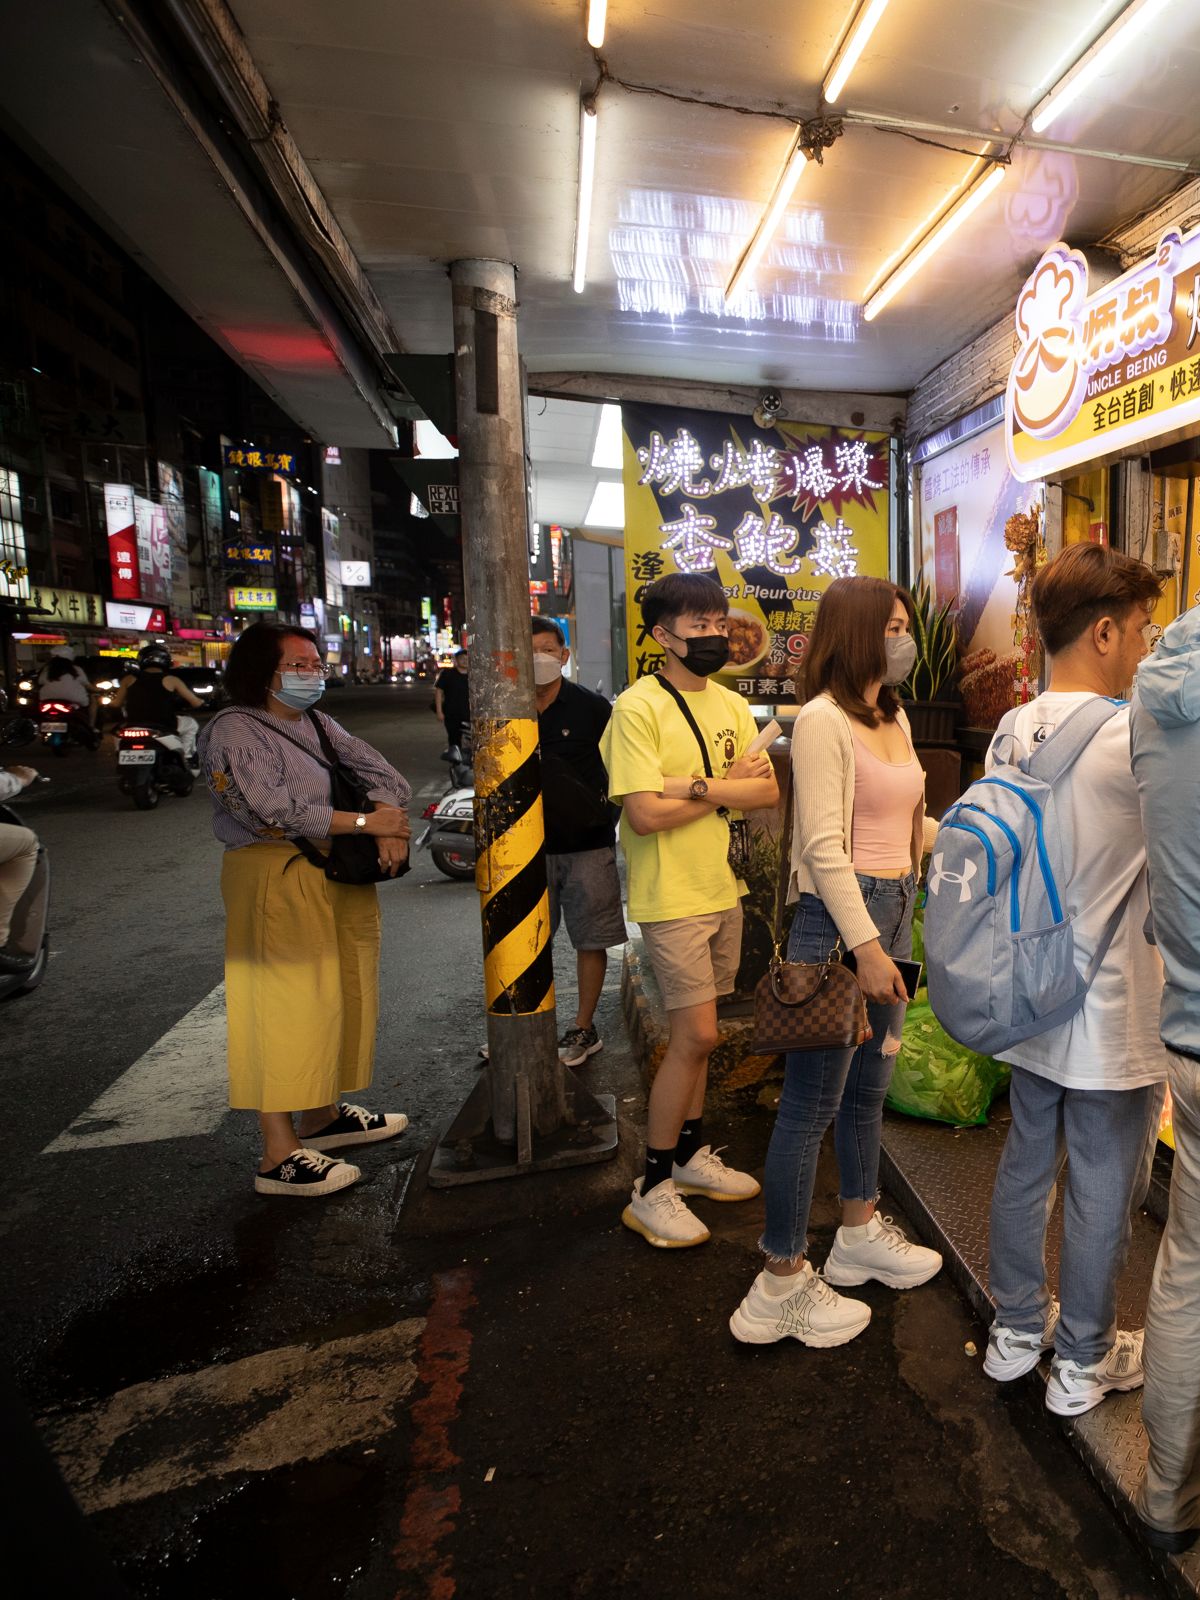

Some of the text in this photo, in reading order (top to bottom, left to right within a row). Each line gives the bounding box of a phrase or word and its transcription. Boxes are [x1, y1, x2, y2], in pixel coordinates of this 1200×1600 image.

[1087, 349, 1168, 397] UNCLE BEING
[743, 584, 821, 601] Pleurotus
[736, 679, 797, 695] 可素食
